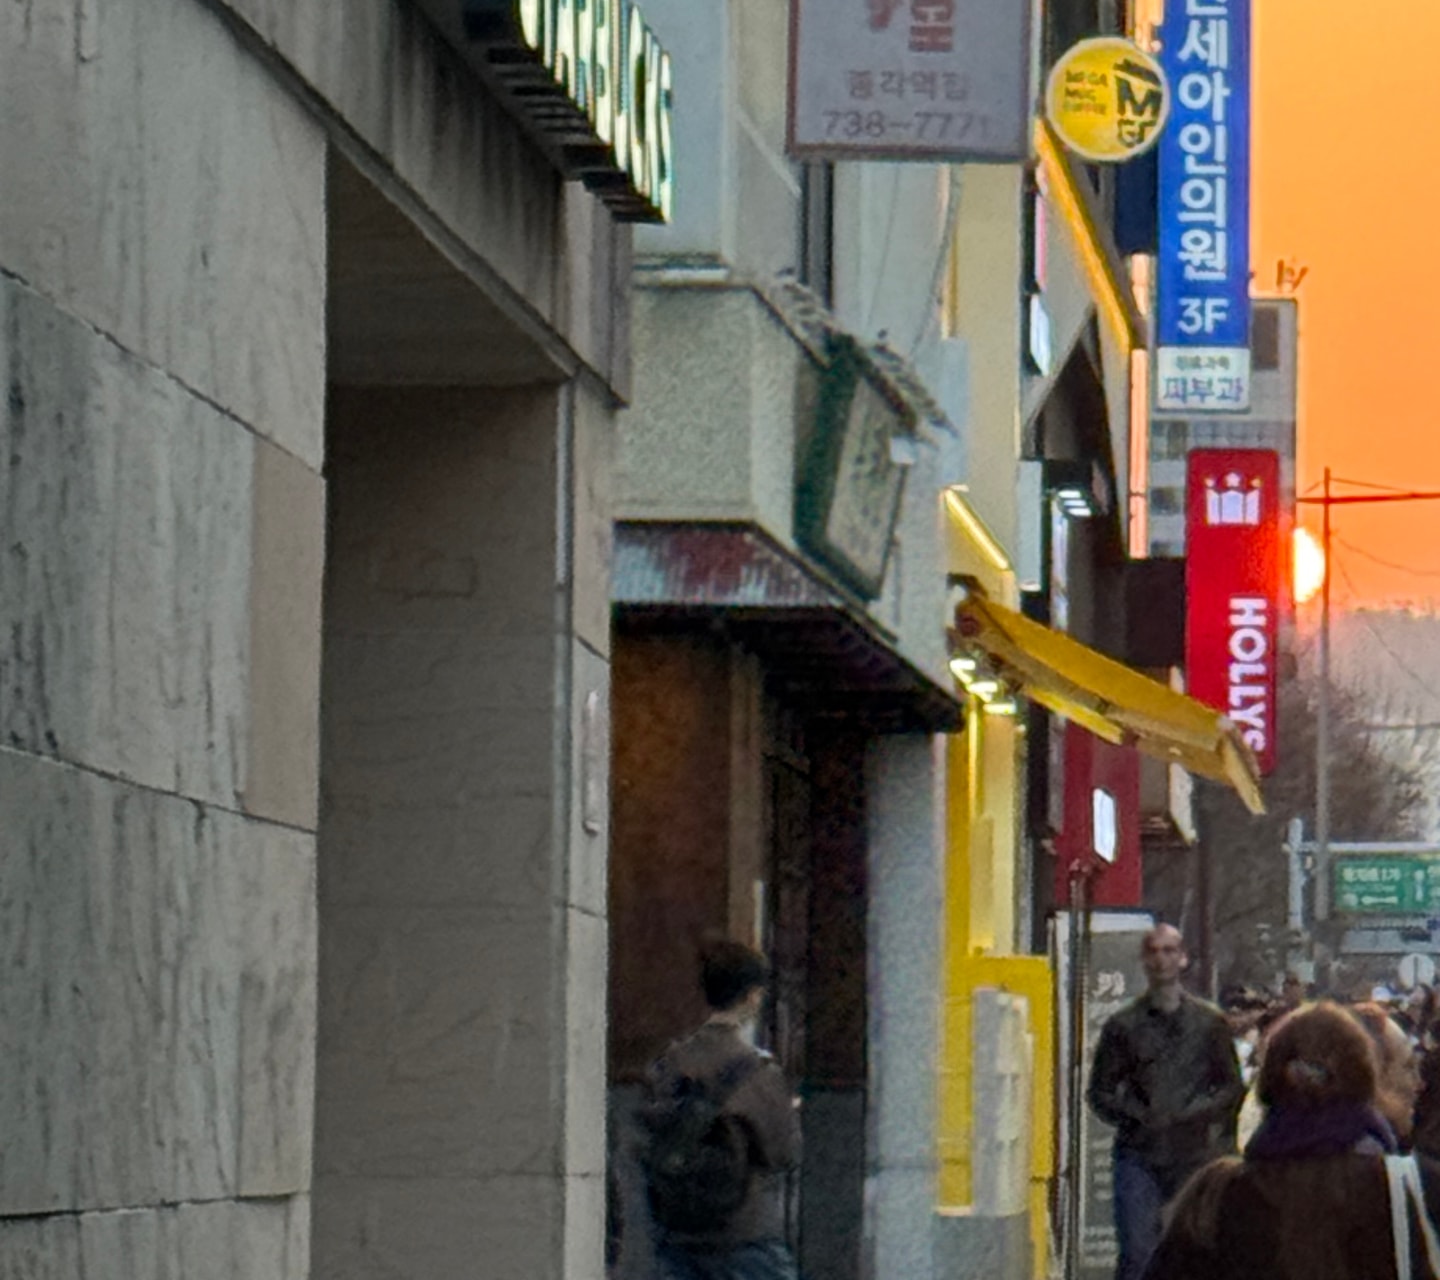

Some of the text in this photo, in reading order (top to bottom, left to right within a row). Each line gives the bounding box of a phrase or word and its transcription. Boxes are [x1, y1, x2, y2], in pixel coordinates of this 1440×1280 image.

[1177, 297, 1230, 335] 3F
[1162, 376, 1245, 404] 피부과
[1228, 596, 1268, 753] HOLLYS
